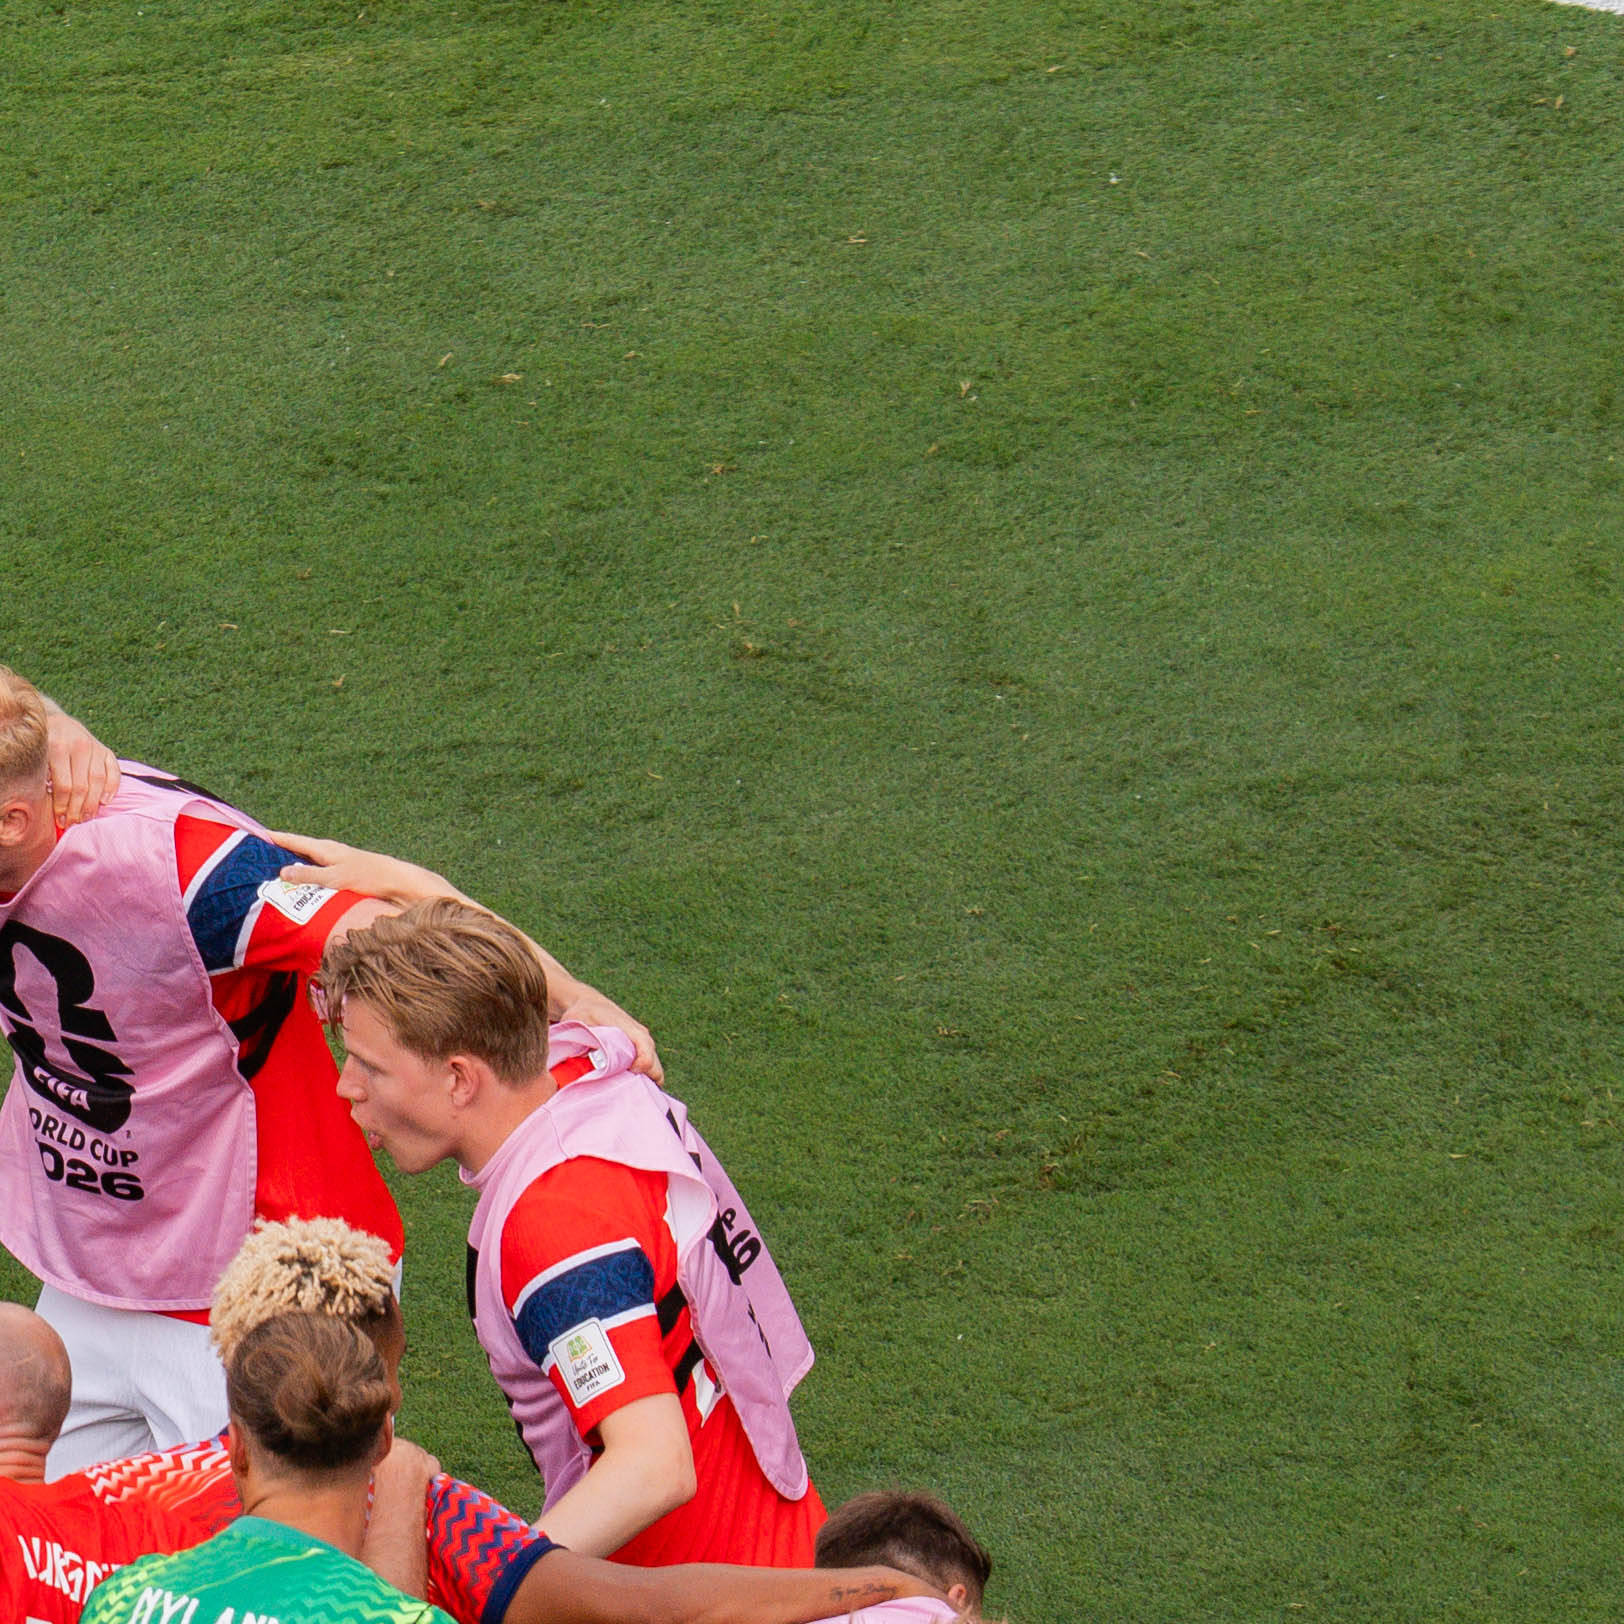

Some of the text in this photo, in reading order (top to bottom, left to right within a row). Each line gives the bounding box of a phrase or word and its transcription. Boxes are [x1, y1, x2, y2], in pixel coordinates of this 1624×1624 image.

[29, 1107, 139, 1167] ORLD CUP
[37, 1140, 144, 1201] 026
